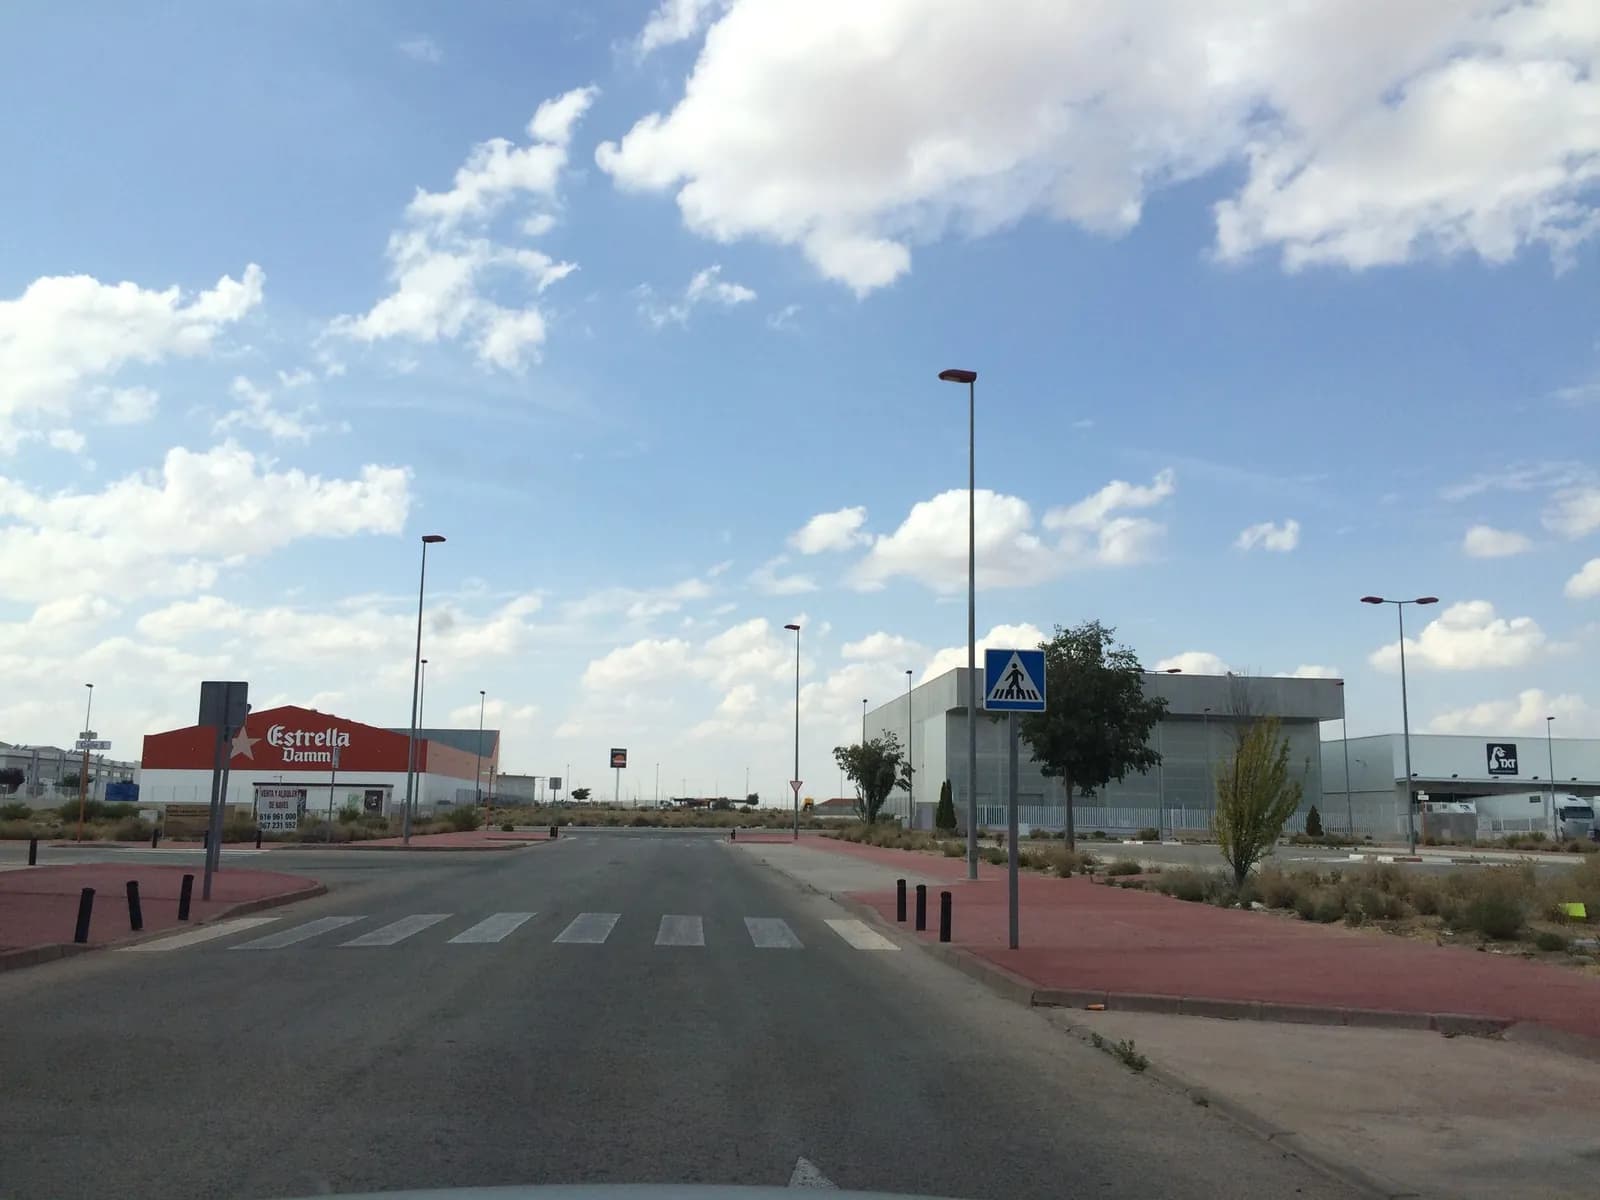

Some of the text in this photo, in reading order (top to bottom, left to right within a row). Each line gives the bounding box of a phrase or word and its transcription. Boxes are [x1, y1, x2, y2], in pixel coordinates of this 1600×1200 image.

[267, 723, 351, 747] Estrella
[282, 747, 331, 762] Damm
[1499, 758, 1516, 769] TXT
